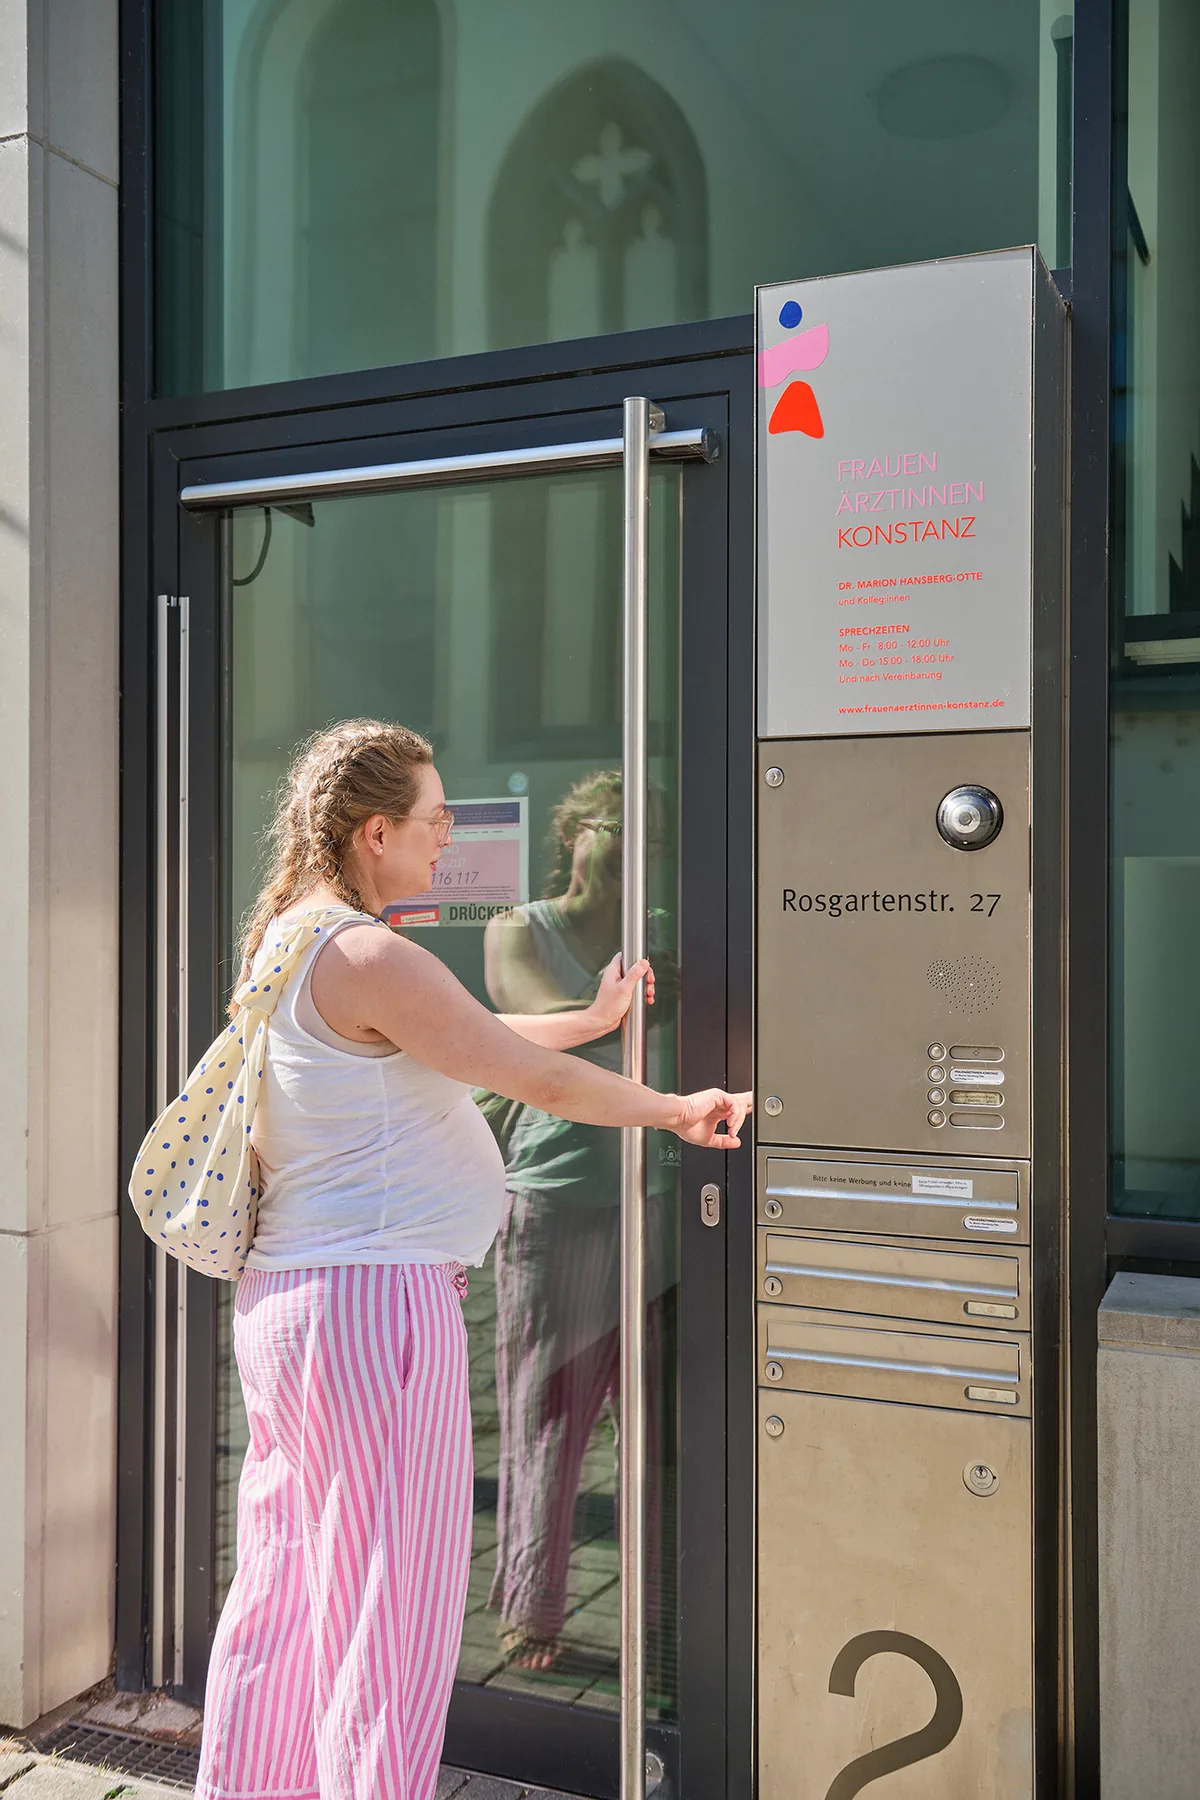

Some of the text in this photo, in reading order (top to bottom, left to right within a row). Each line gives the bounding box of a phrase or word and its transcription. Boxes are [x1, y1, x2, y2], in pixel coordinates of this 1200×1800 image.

[837, 451, 937, 482] FRAUEN
[836, 481, 985, 516] ÄRZTINNEN
[837, 516, 977, 549] KONSTANZ
[838, 572, 983, 591] DR. MARION HANSBERG-OTTE
[838, 594, 911, 607] und Kolleg:innen
[838, 624, 910, 637] SPRECHZEITEN
[838, 643, 854, 652] Mo
[862, 642, 871, 651] Fr
[878, 641, 897, 650] 8:00
[906, 638, 931, 649] 12:00
[933, 638, 950, 648] Uhr
[838, 659, 854, 668] Mo
[861, 658, 875, 667] Do
[879, 656, 903, 666] 15:00
[911, 654, 936, 664] 18:00
[938, 653, 955, 663] Uhr
[838, 671, 943, 684] Und nach Vereinbarung
[838, 698, 1005, 714] www.frauenaerztinnen-konstanz.de
[431, 871, 479, 886] 116 117
[782, 888, 1002, 918] Rosgartenstr. 27
[449, 903, 514, 921] DRÜCKEN
[812, 1174, 828, 1183] Bitte
[829, 1175, 847, 1184] keine
[848, 1177, 877, 1187] Werbung
[826, 1630, 964, 1800] 2
